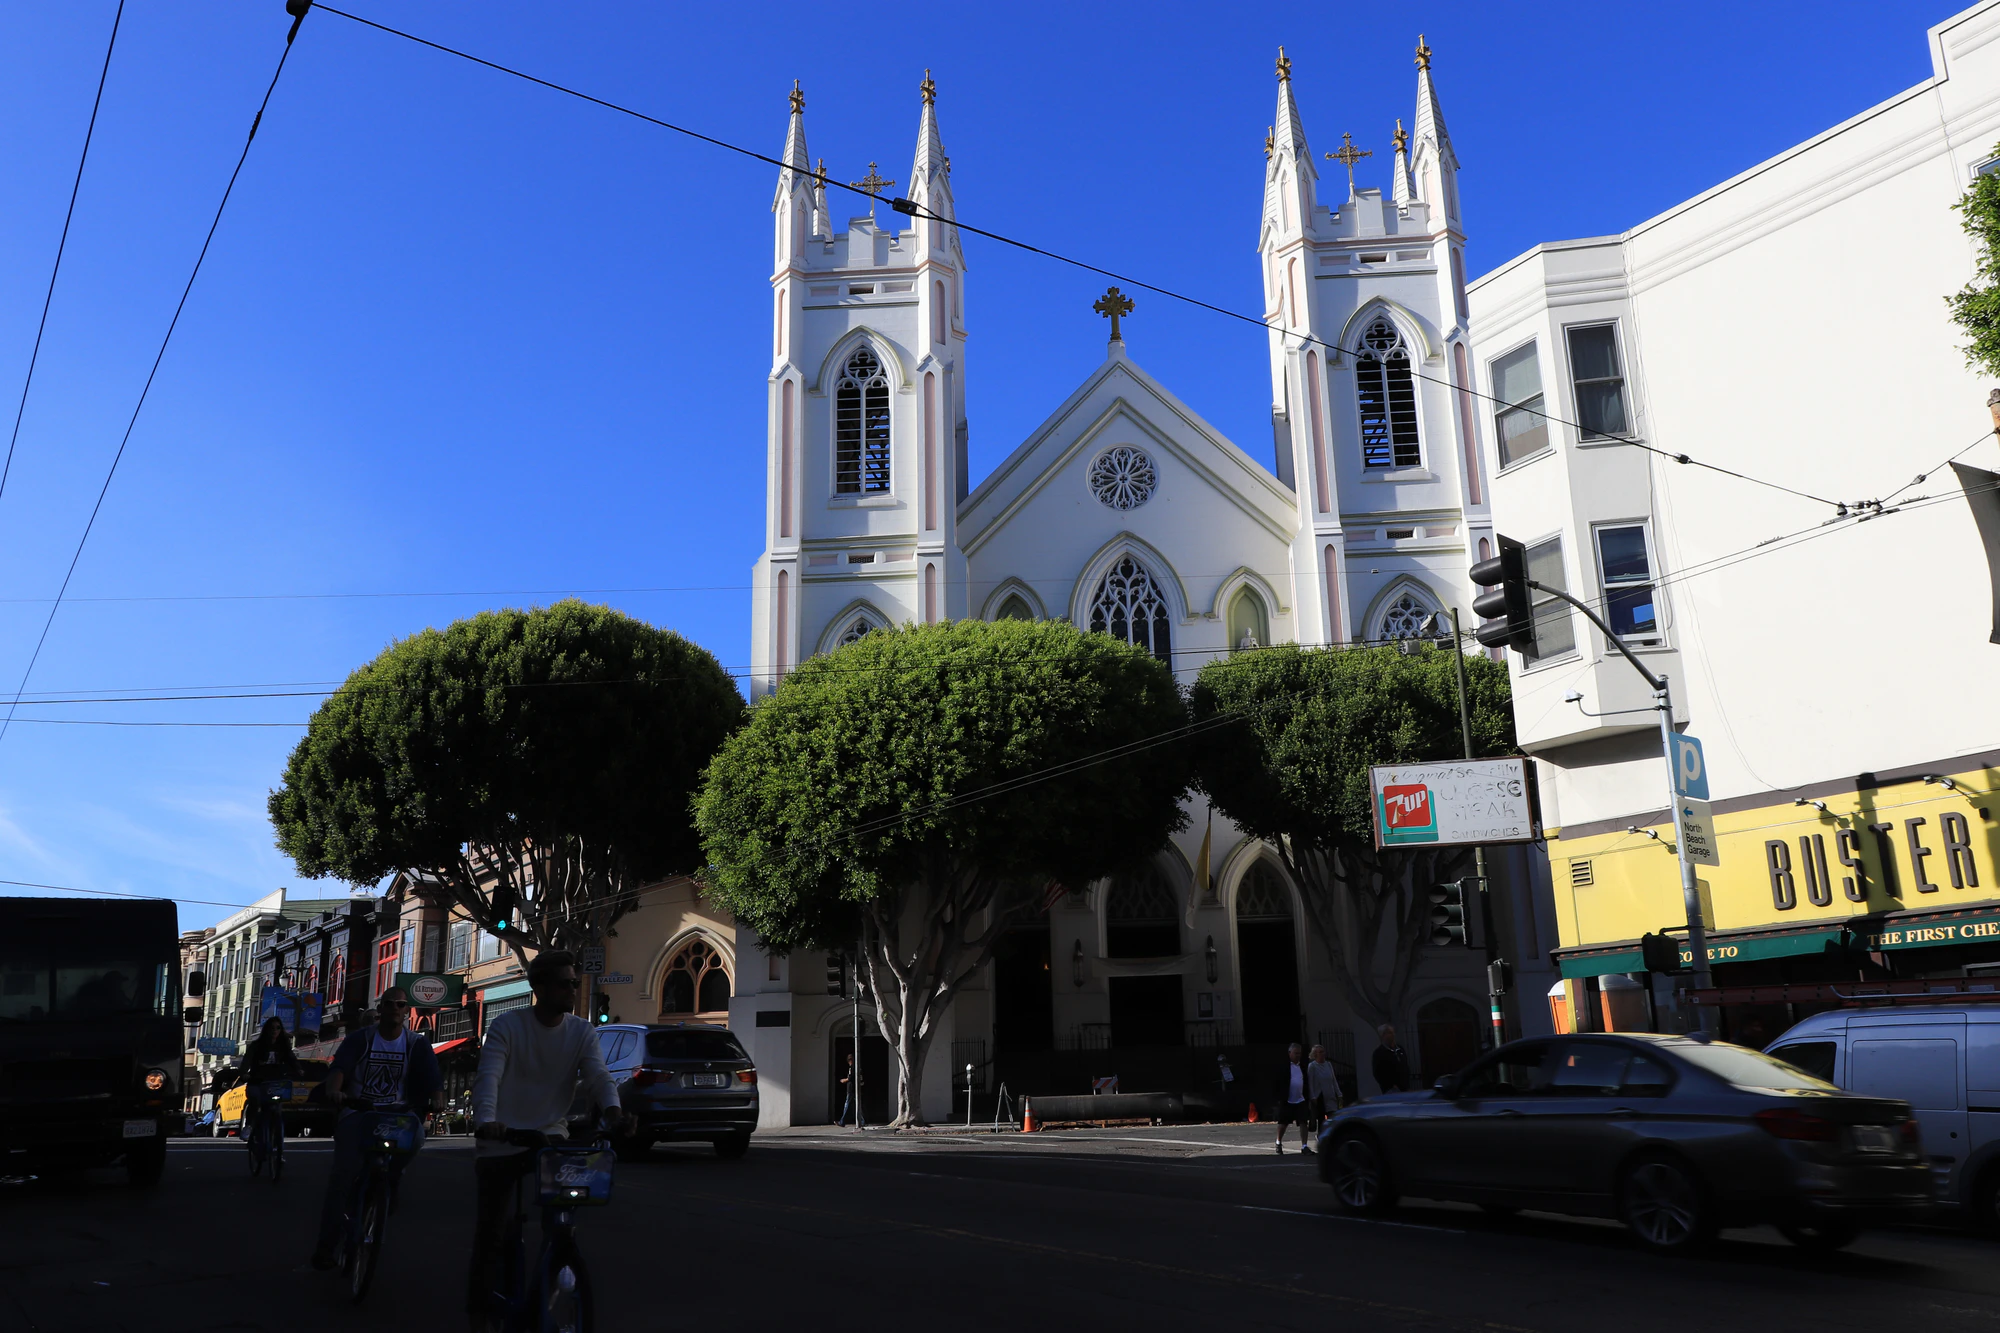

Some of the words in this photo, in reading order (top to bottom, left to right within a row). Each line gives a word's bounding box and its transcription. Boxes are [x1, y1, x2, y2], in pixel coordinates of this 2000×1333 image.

[1683, 822, 1703, 834] North
[1685, 833, 1706, 845] Beach
[1687, 844, 1711, 858] Garage
[1867, 932, 1902, 946] THE
[1905, 926, 1956, 943] FIRST
[1960, 921, 2000, 938] CHE
[1718, 946, 1738, 959] TO
[585, 961, 603, 972] 25
[372, 1122, 406, 1137] Ford
[554, 1163, 598, 1182] Ford
